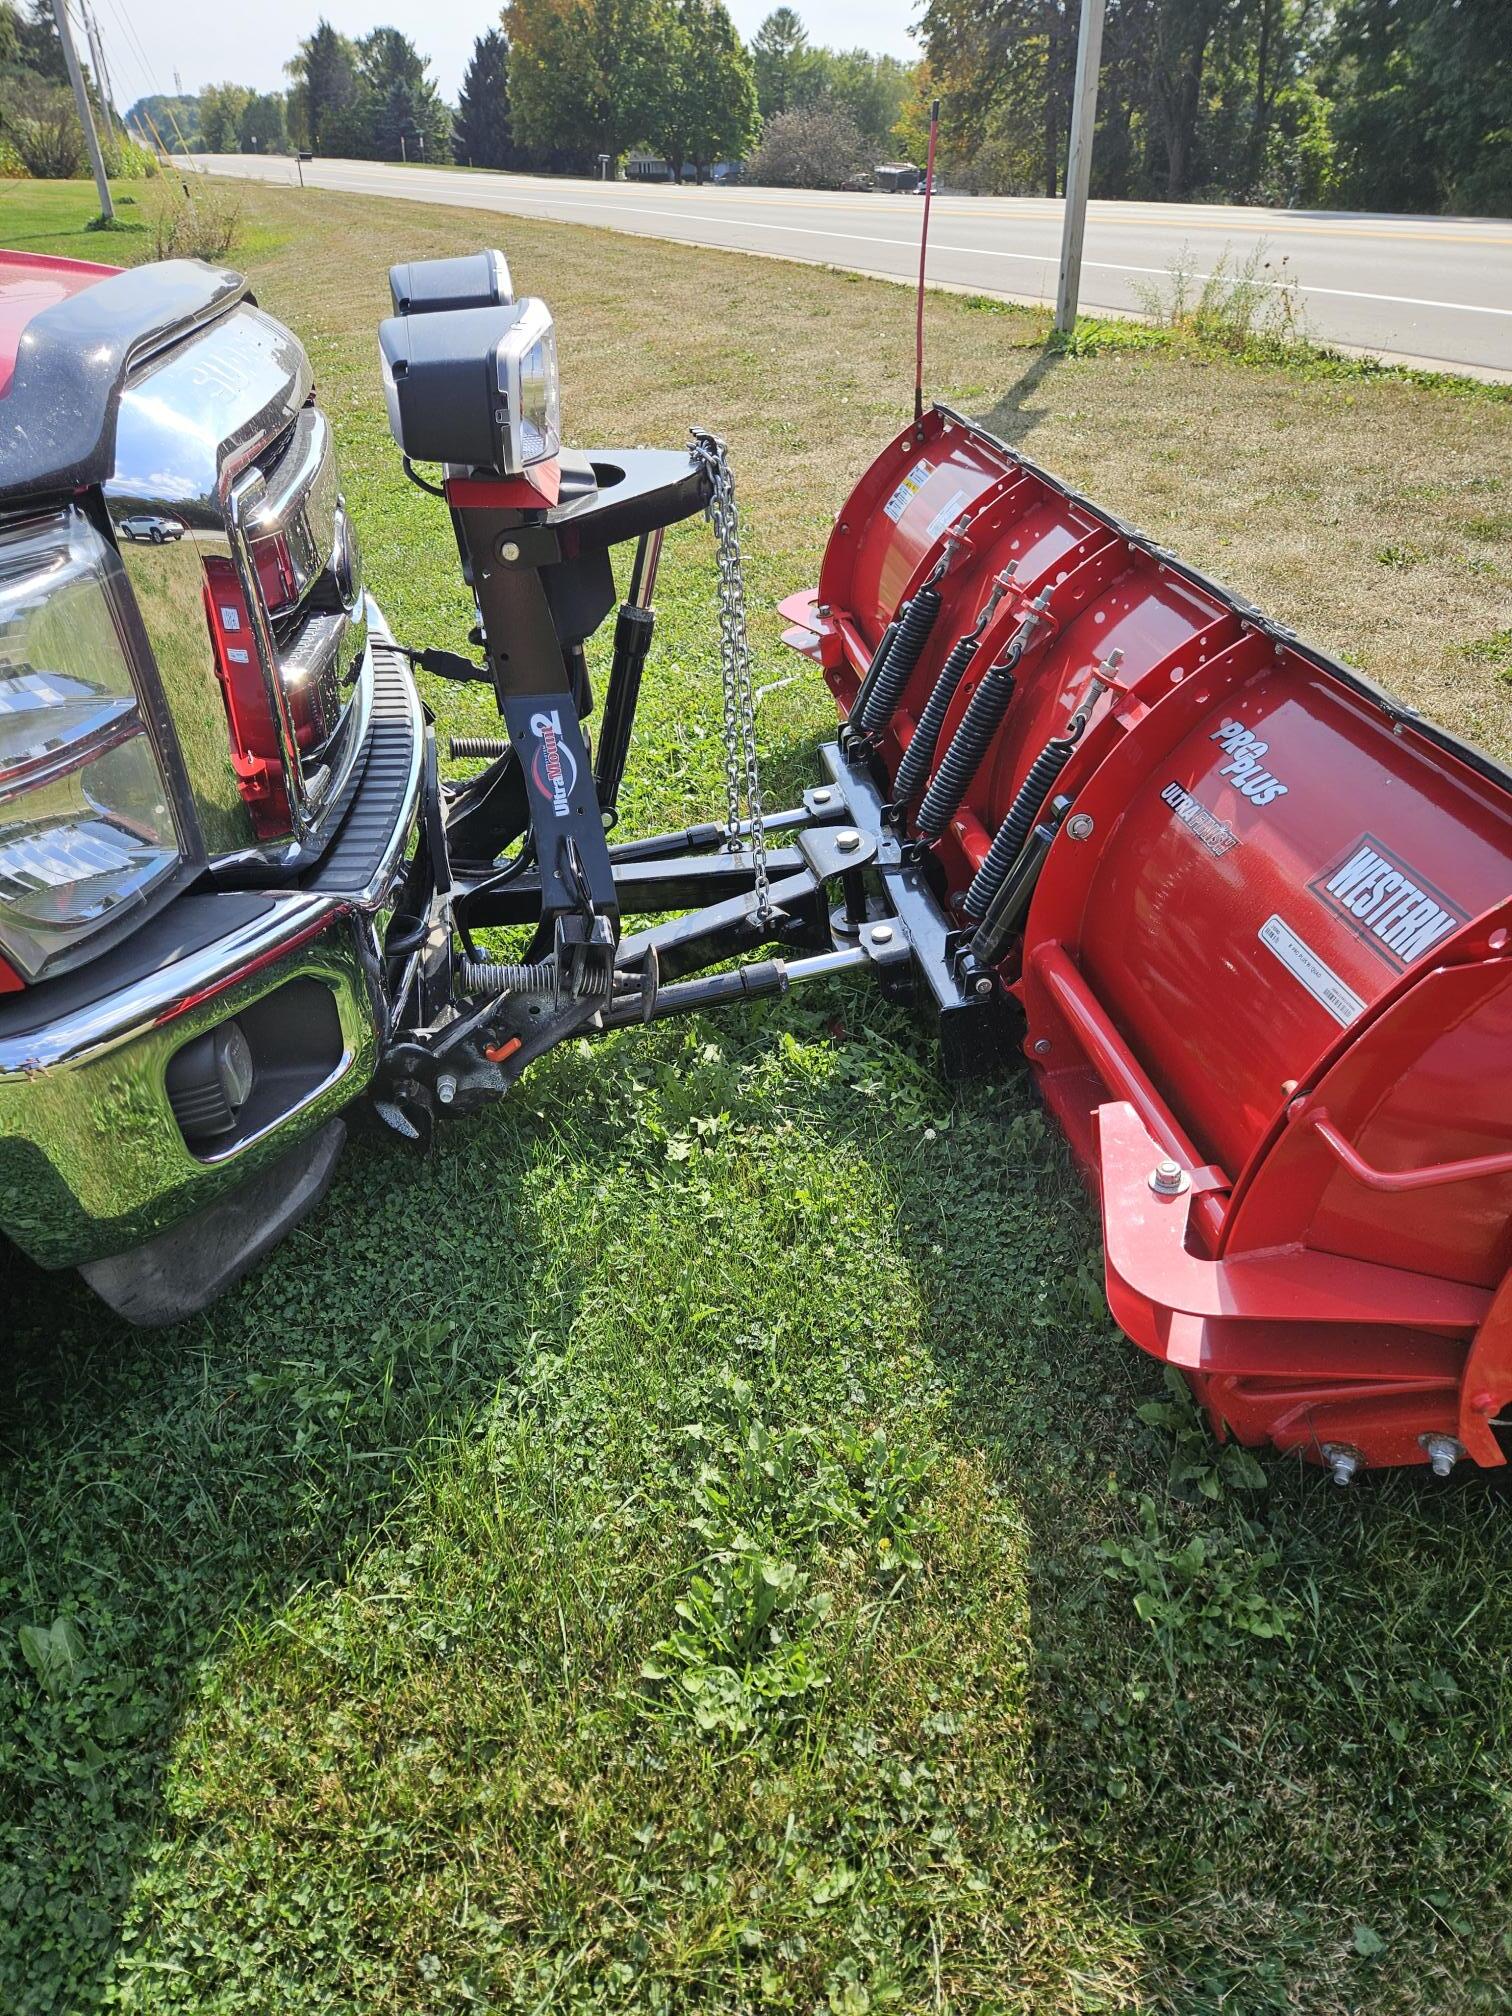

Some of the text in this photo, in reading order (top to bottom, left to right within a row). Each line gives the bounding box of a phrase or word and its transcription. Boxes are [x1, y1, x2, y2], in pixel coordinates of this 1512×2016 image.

[1209, 721, 1269, 761] PRO
[1219, 756, 1289, 806] PLUS
[1326, 846, 1457, 963] WESTERN
